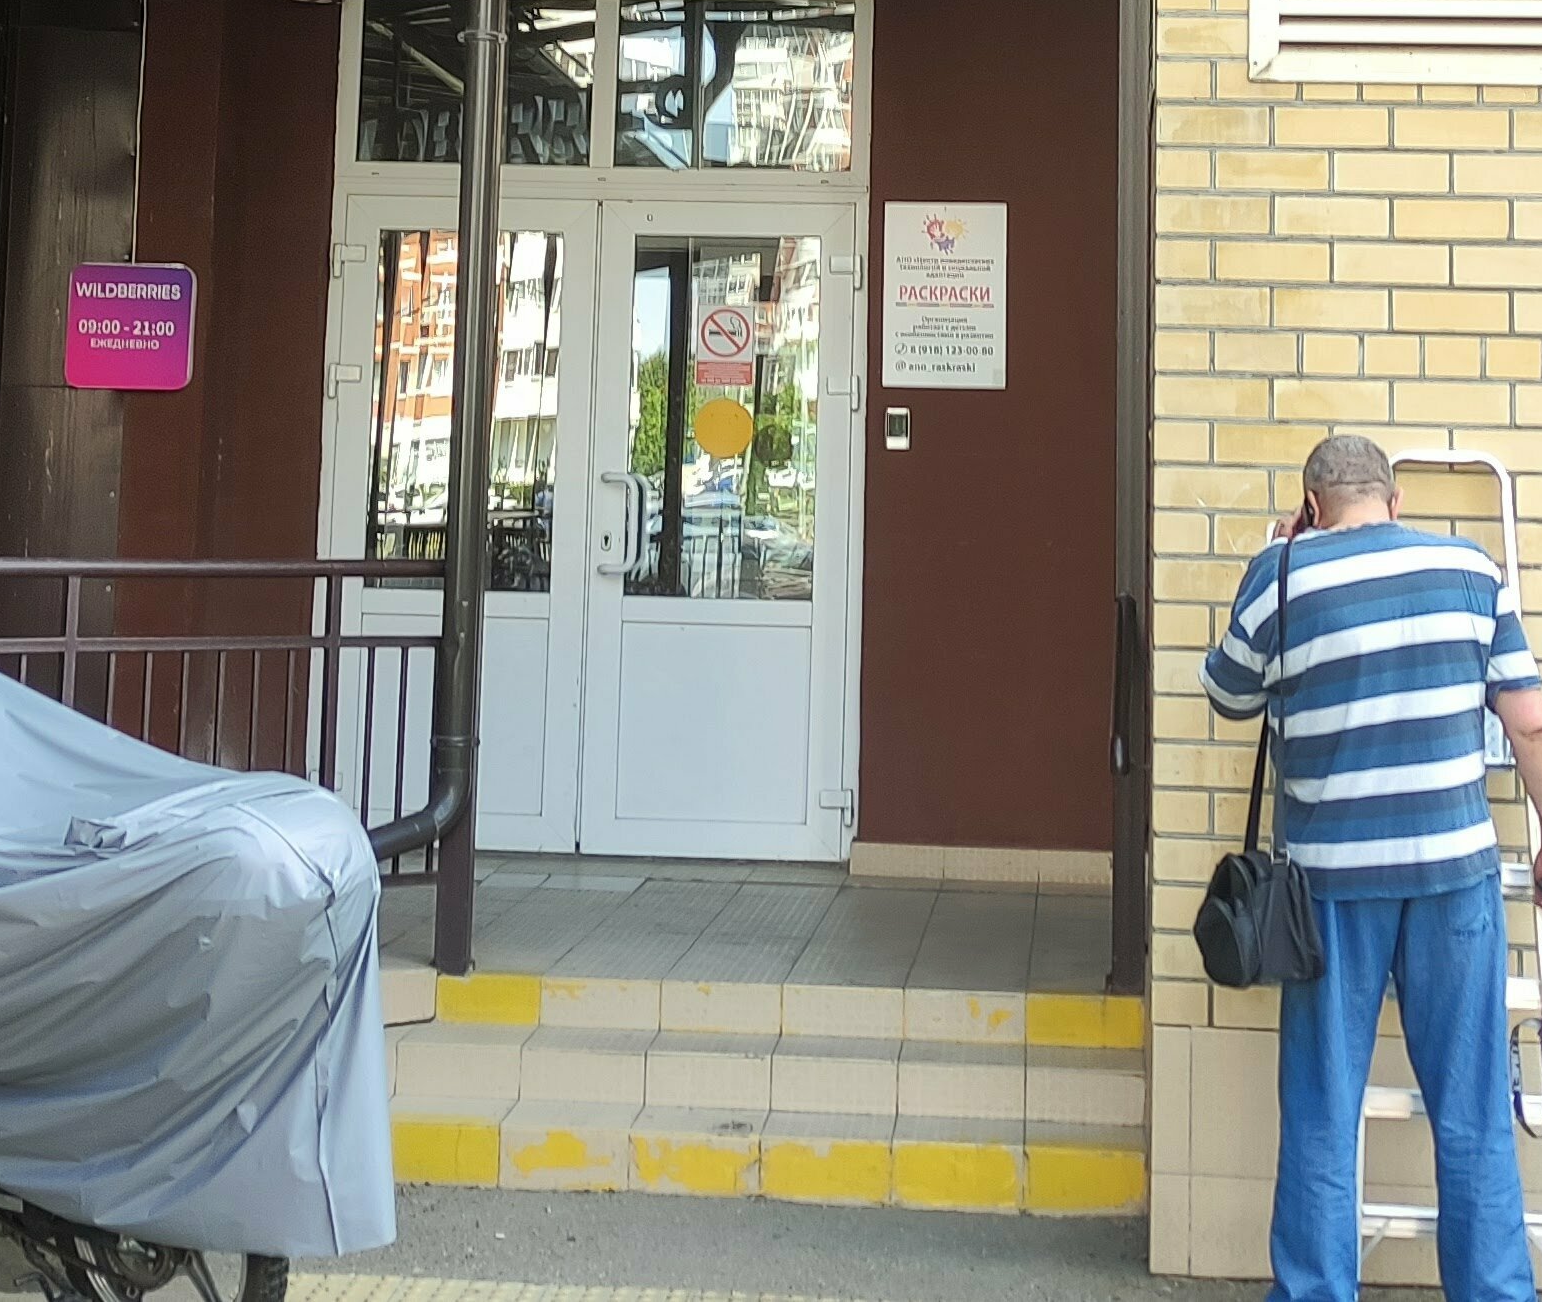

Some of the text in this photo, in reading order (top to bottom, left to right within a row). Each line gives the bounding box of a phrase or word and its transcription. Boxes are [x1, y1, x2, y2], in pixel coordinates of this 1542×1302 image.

[75, 281, 182, 301] WILDBERRIES
[899, 284, 991, 302] РАСКРАСКИ
[78, 318, 121, 335] 09:00
[133, 320, 175, 337] 21:00
[90, 337, 160, 350] ЕЖЕДНЕВНО
